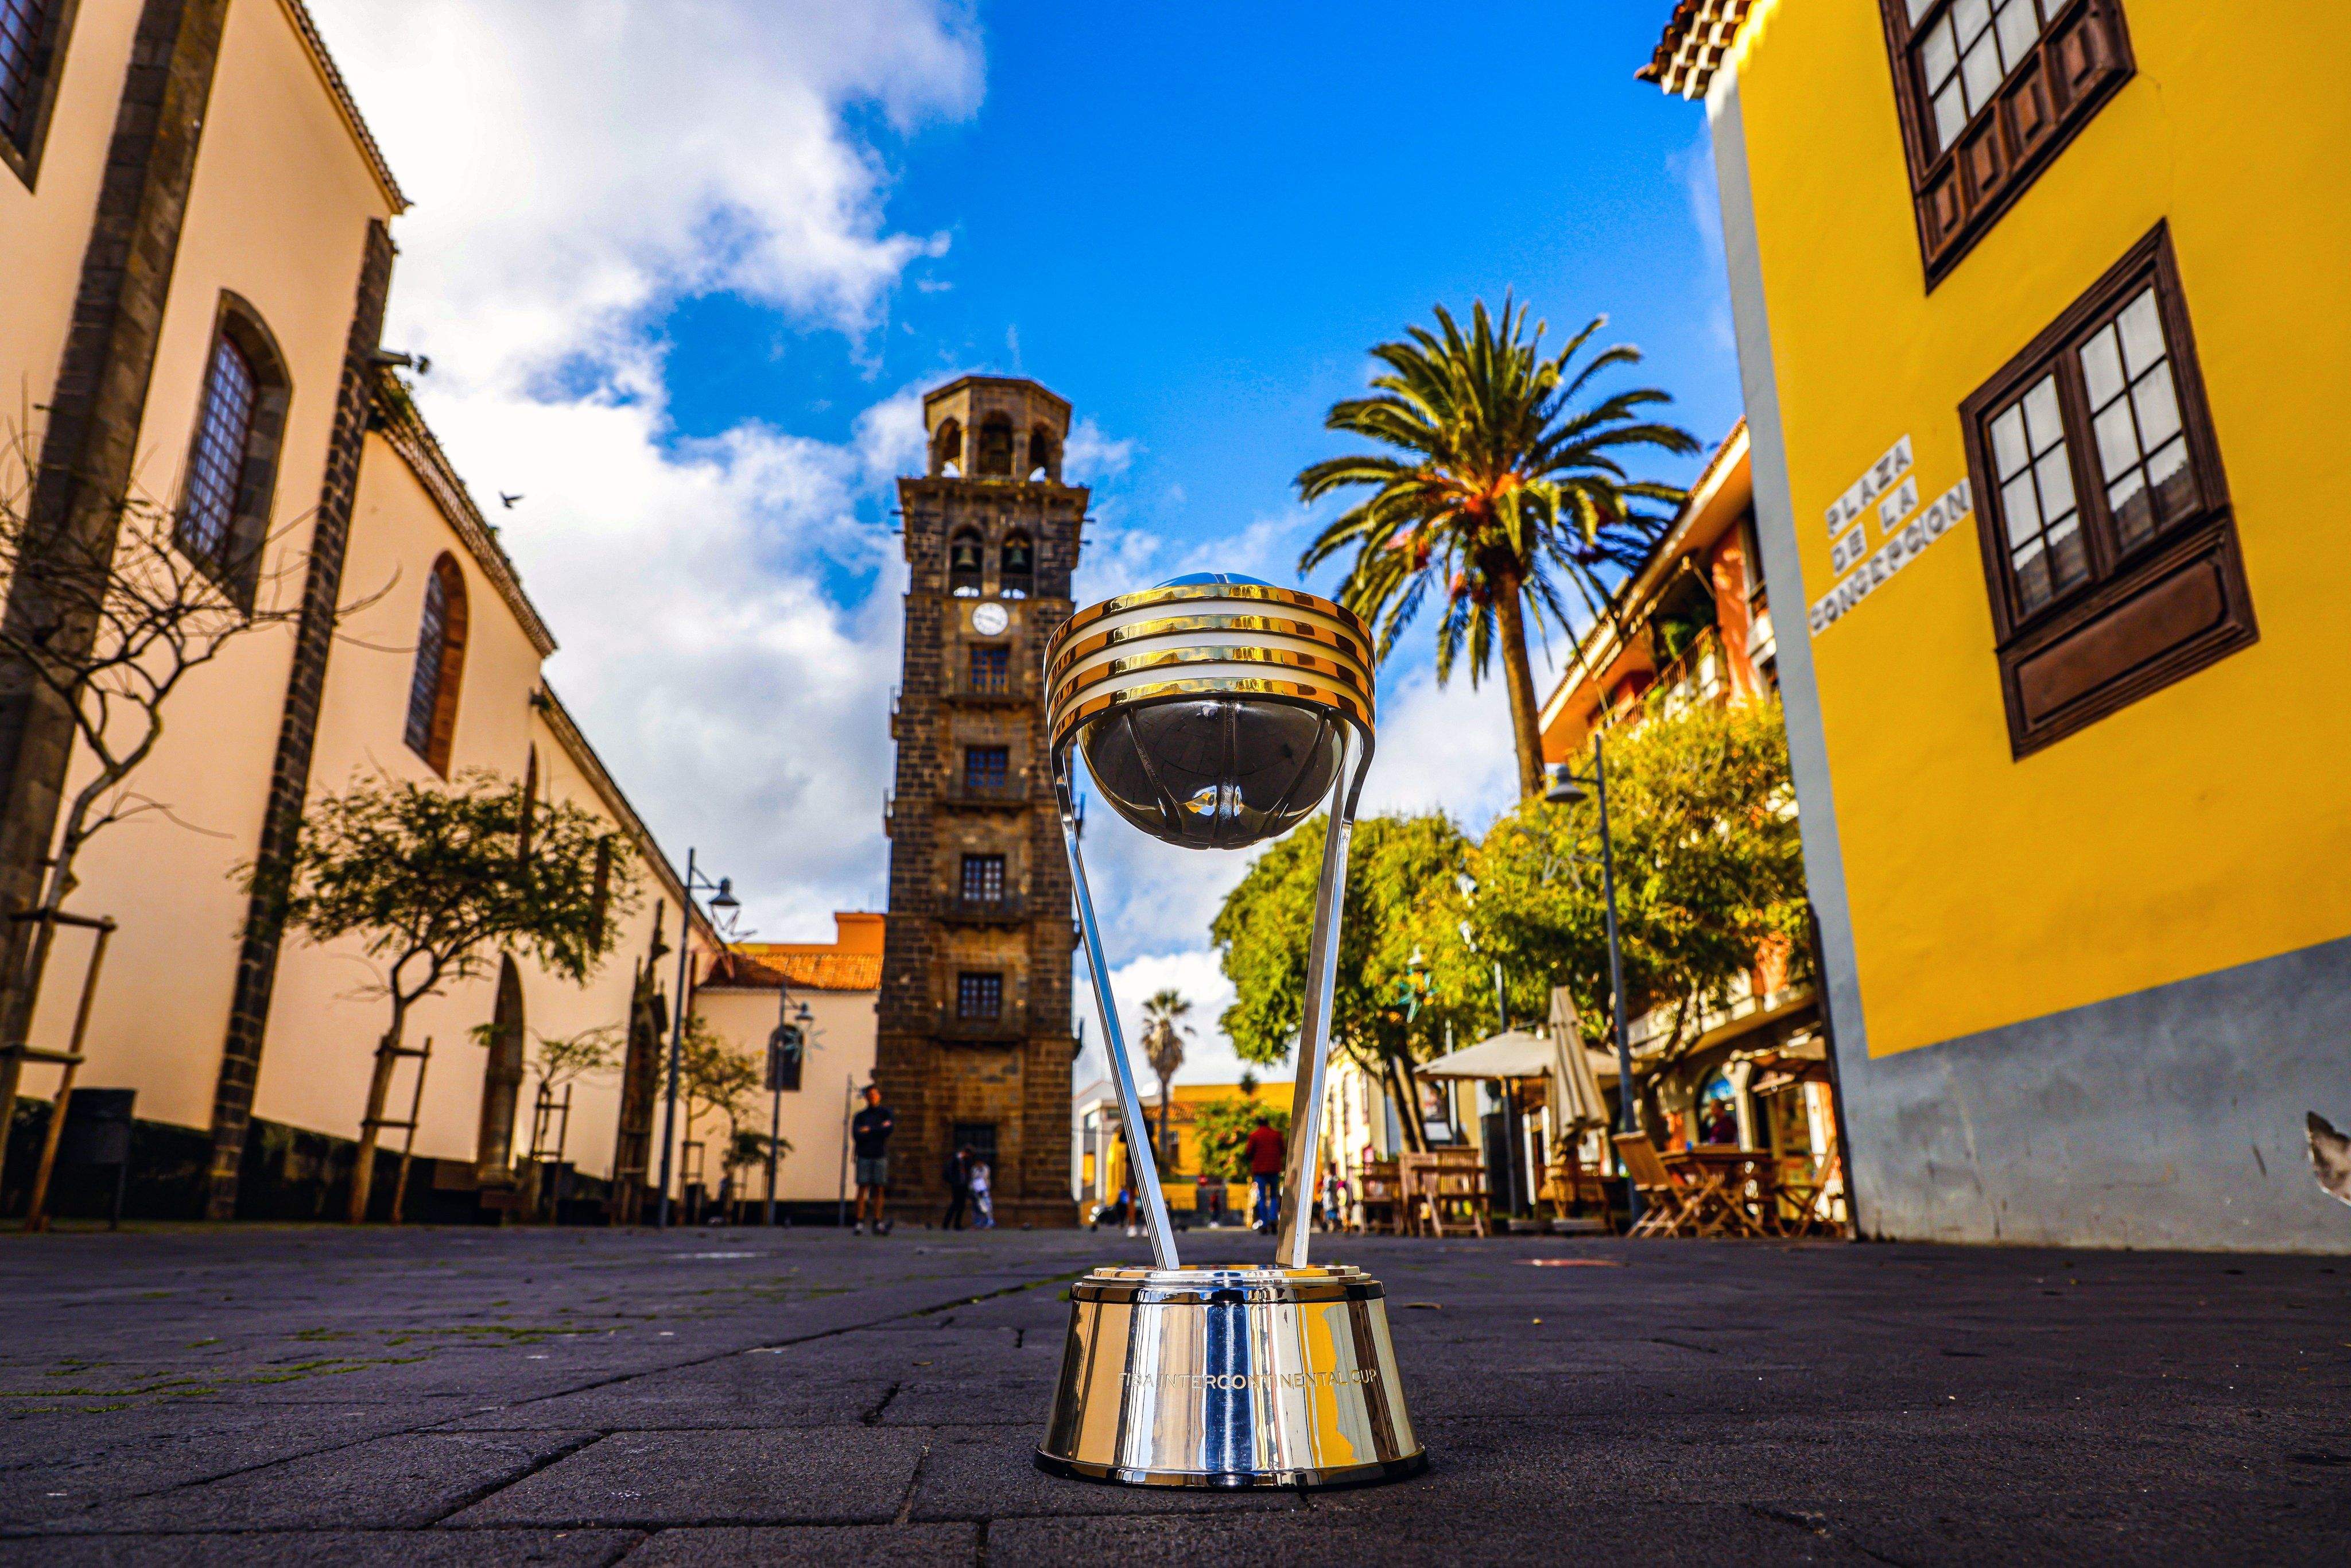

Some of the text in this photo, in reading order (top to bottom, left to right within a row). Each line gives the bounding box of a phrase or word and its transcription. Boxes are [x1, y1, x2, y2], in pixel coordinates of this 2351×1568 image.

[1826, 442, 1911, 535] PLAZA
[1831, 483, 1917, 573] DE LA
[1810, 482, 1970, 632] CONCEPCION
[1118, 1368, 1378, 1390] FIBA INTERCONTINENTAL CUP
